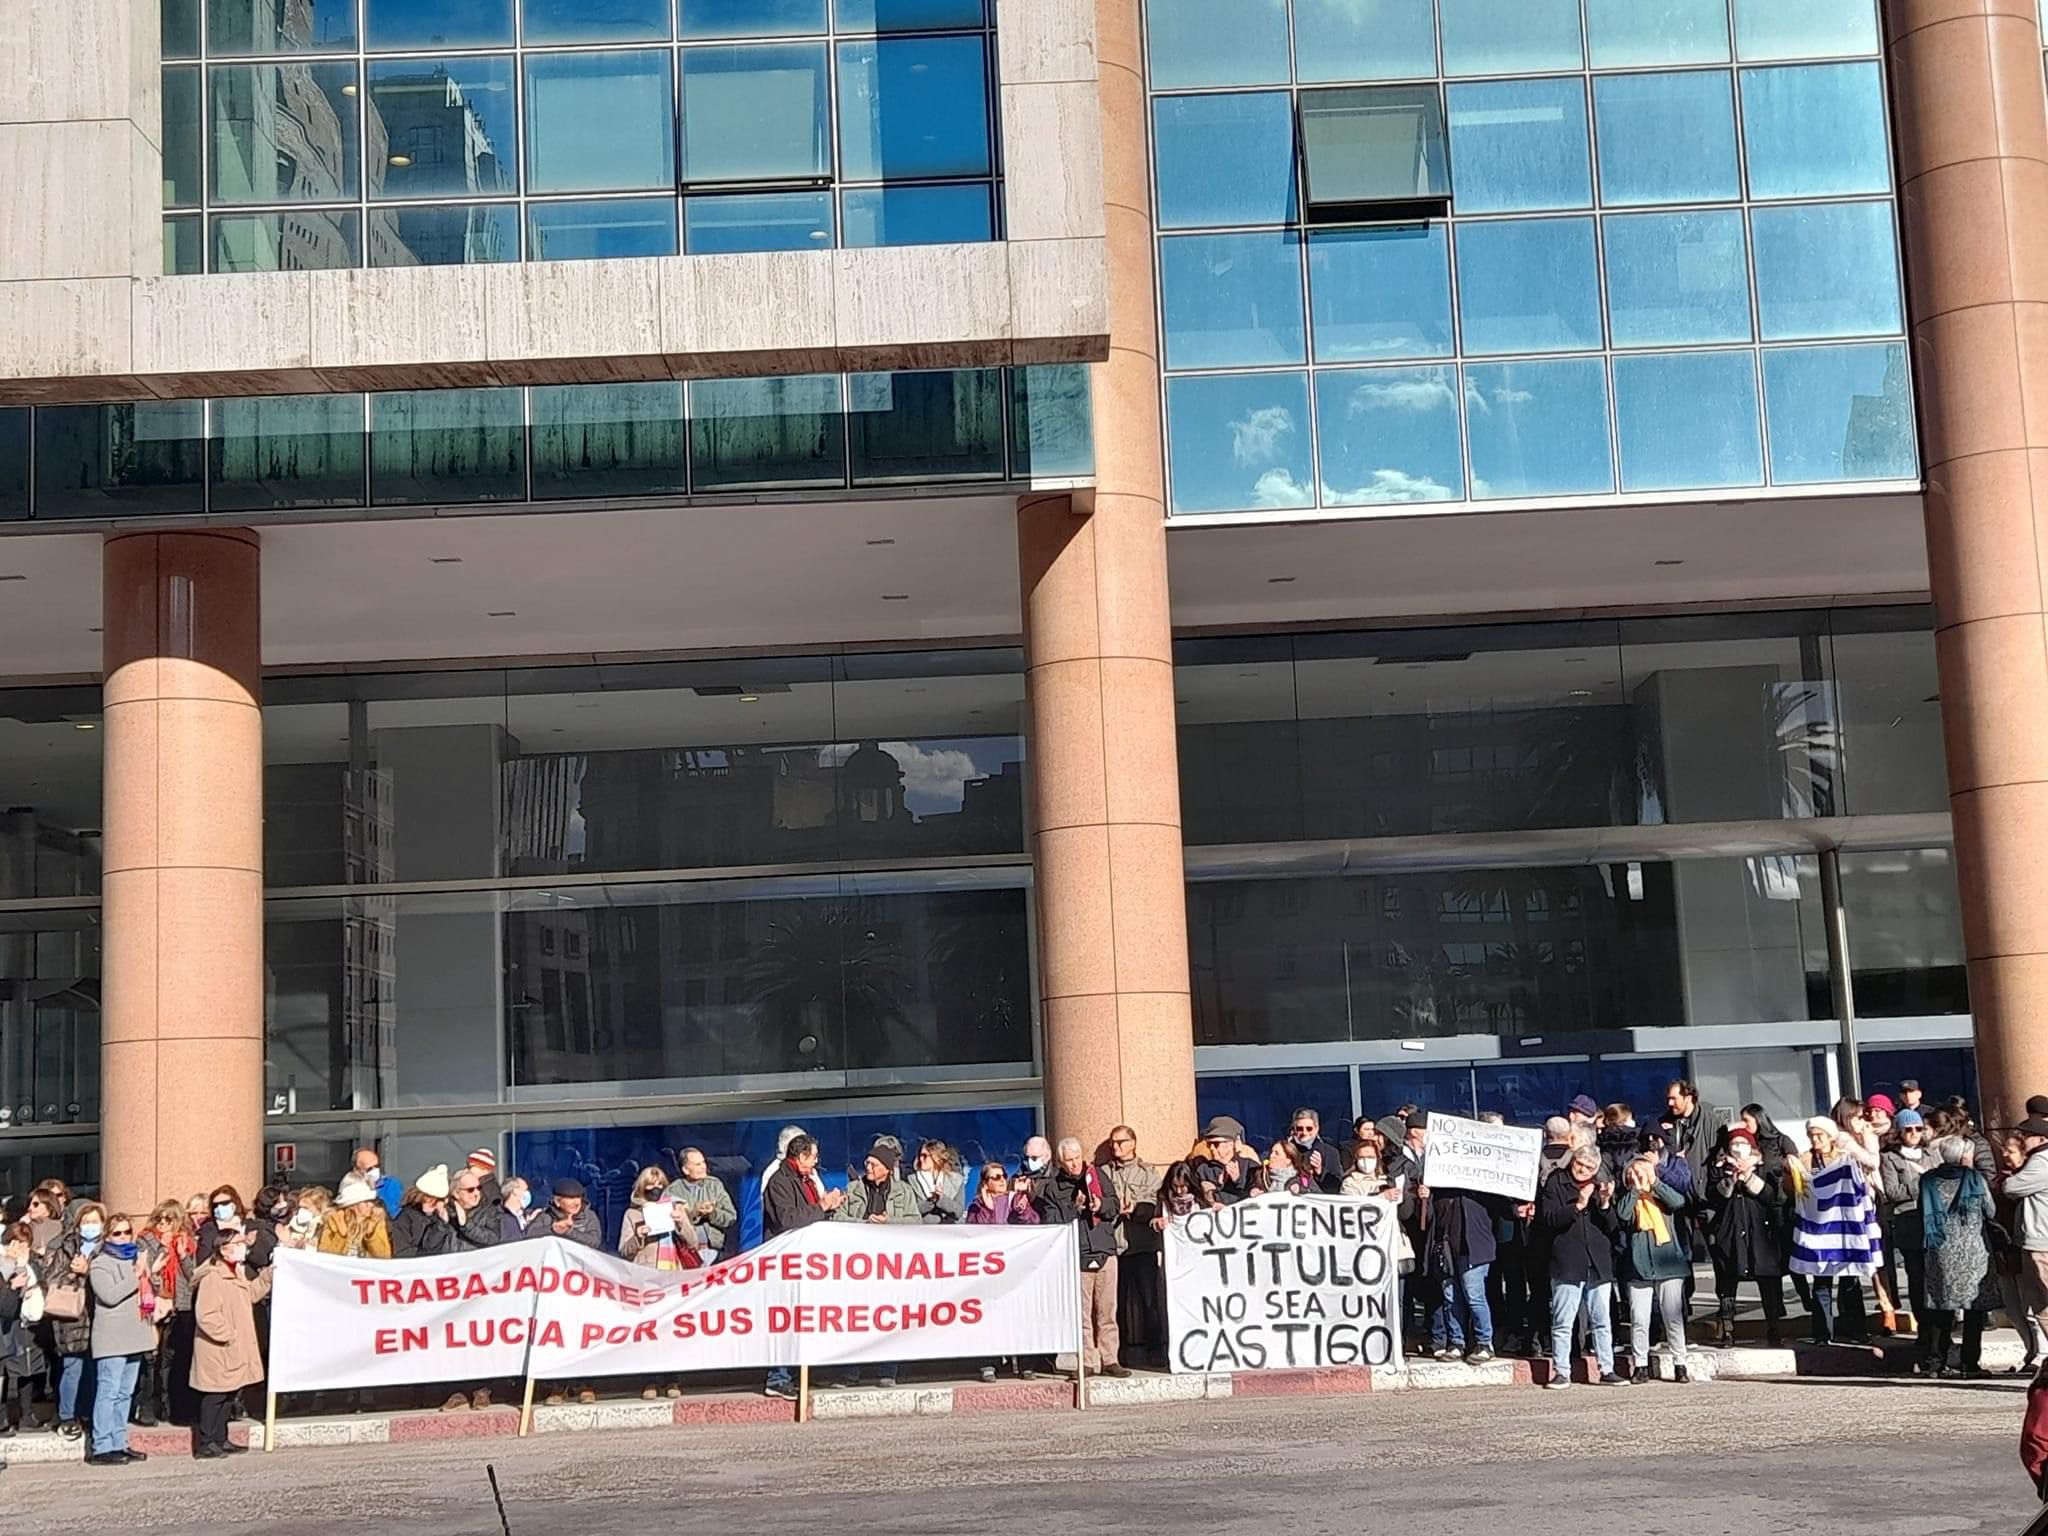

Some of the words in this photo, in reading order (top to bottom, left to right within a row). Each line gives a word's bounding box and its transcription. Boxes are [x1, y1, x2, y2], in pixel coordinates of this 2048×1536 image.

[1431, 1118, 1457, 1134] NO
[1428, 1141, 1492, 1158] ASESINO
[1185, 1202, 1263, 1246] QUE
[1268, 1202, 1384, 1243] TENER
[1202, 1240, 1387, 1287] TÍTULO
[351, 1265, 666, 1307] TRABAJADORES
[1202, 1292, 1247, 1324] NO
[1266, 1290, 1326, 1319] SEA
[1342, 1293, 1388, 1321] UN
[375, 1326, 430, 1355] EN
[581, 1320, 658, 1350] POR
[672, 1307, 754, 1339] SUS
[768, 1297, 984, 1334] DERECHOS
[1178, 1323, 1394, 1372] CASTIGO
